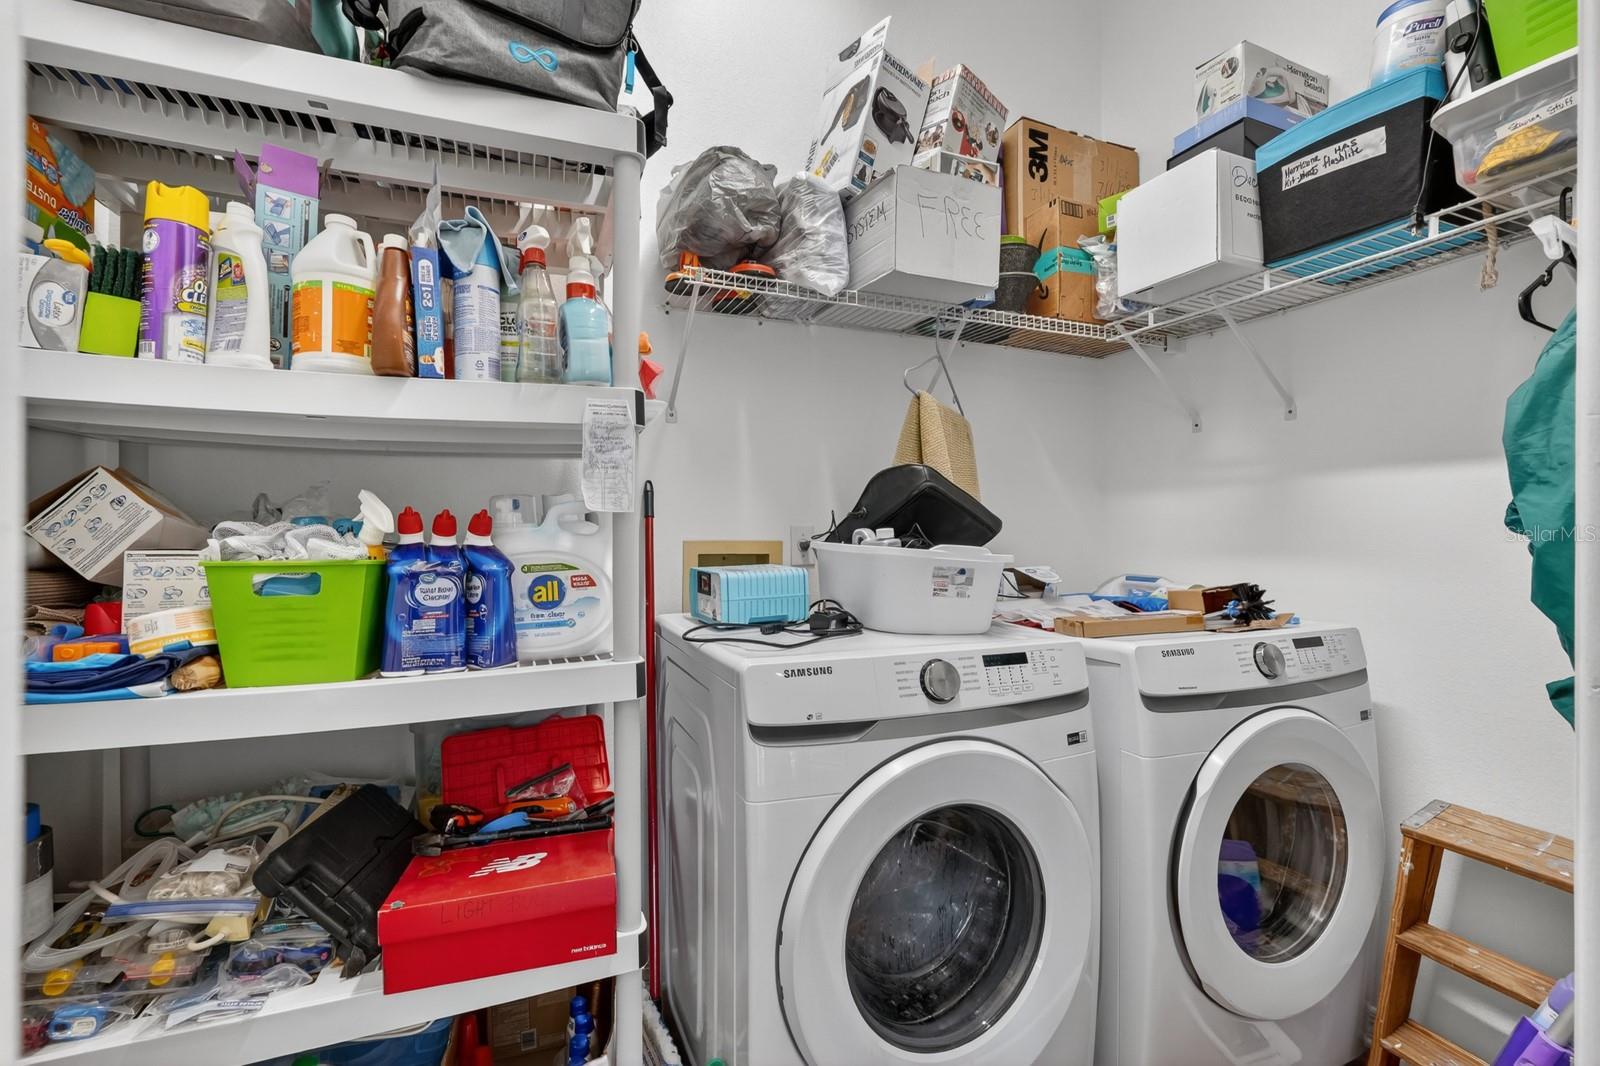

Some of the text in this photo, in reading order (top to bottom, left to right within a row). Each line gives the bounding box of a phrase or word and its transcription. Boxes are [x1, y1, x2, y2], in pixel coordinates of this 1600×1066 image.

[1406, 17, 1442, 36] Purell
[1286, 64, 1318, 84] Hamilton
[1304, 79, 1325, 95] Beach
[1028, 128, 1049, 183] 3M
[917, 193, 986, 241] FREE
[532, 580, 559, 603] all
[783, 666, 833, 679] SAMSUNG
